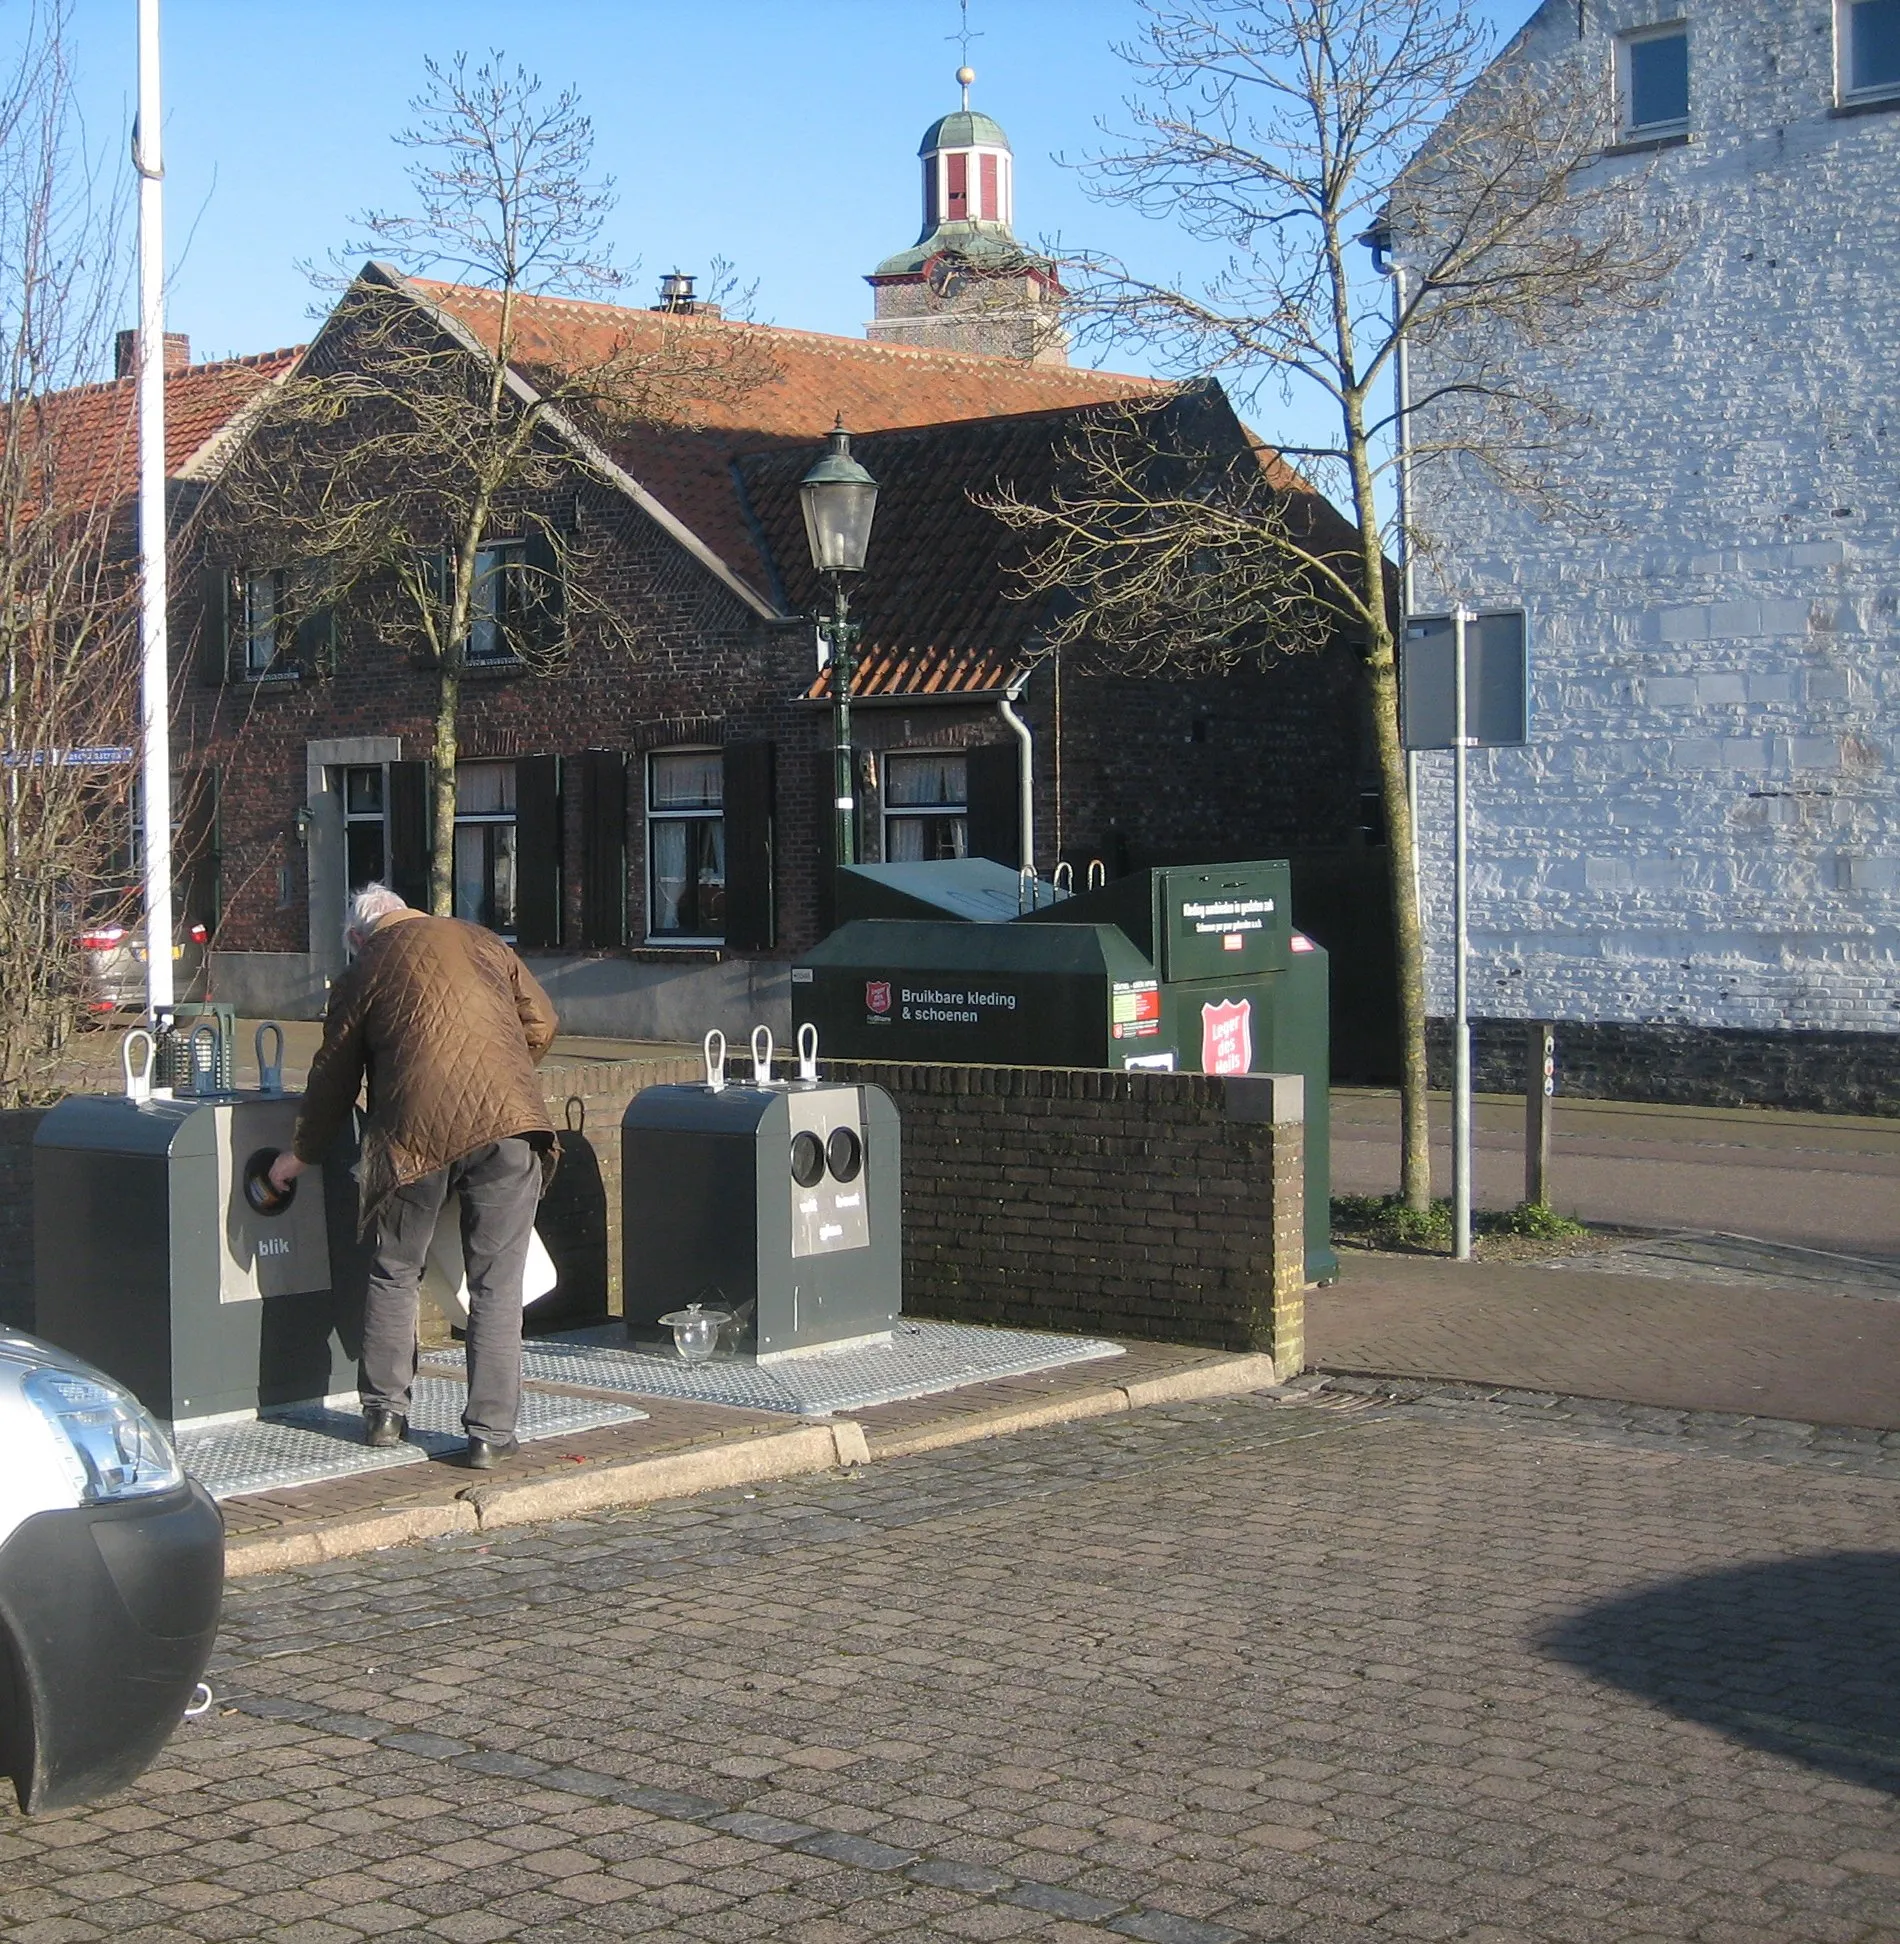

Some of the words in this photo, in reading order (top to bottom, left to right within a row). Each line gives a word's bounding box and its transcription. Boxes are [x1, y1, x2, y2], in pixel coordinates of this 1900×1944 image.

[901, 989, 964, 1005] Bruikbare
[967, 991, 1016, 1010] kleding
[901, 1006, 911, 1020] &
[914, 1008, 978, 1022] schoenen
[1211, 1015, 1241, 1041] Leger
[1217, 1038, 1236, 1057] des
[1215, 1053, 1240, 1074] Heils
[258, 1238, 290, 1257] blik
